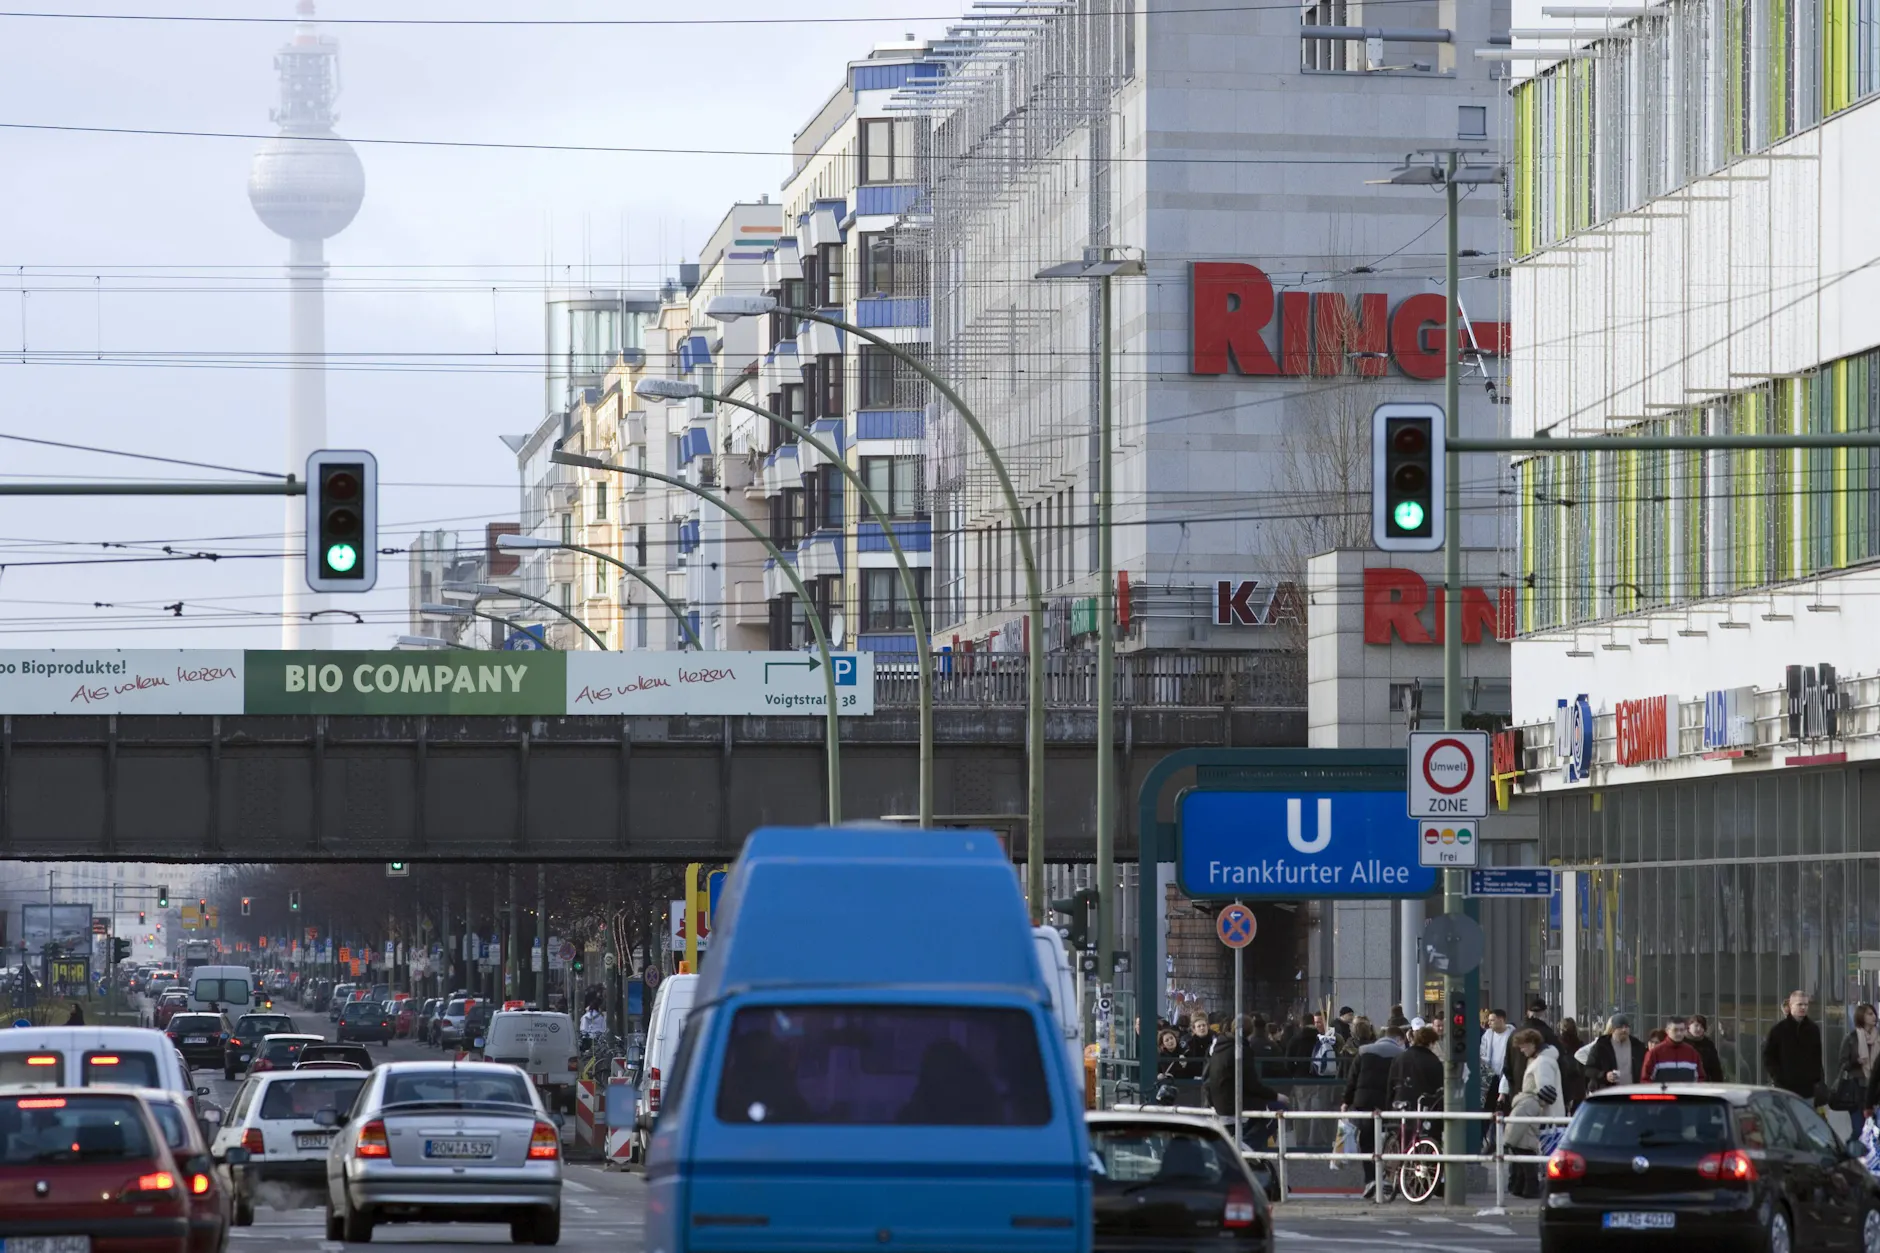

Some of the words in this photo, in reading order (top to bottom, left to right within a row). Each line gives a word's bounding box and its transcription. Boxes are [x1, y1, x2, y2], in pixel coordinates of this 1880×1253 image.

[22, 660, 127, 678] Bioprodukte!
[177, 666, 237, 683] Herzen
[678, 667, 736, 684] Herzen
[285, 663, 343, 694] BIO
[352, 663, 528, 694] COMPANY
[842, 694, 857, 707] 38
[1704, 690, 1727, 749] ALDI
[1430, 761, 1467, 772] Umwelt
[1428, 798, 1468, 812] ZONE
[1287, 798, 1332, 854] U
[1439, 851, 1457, 862] frei
[1209, 859, 1342, 884] Frankfurter
[1350, 859, 1410, 884] Allee
